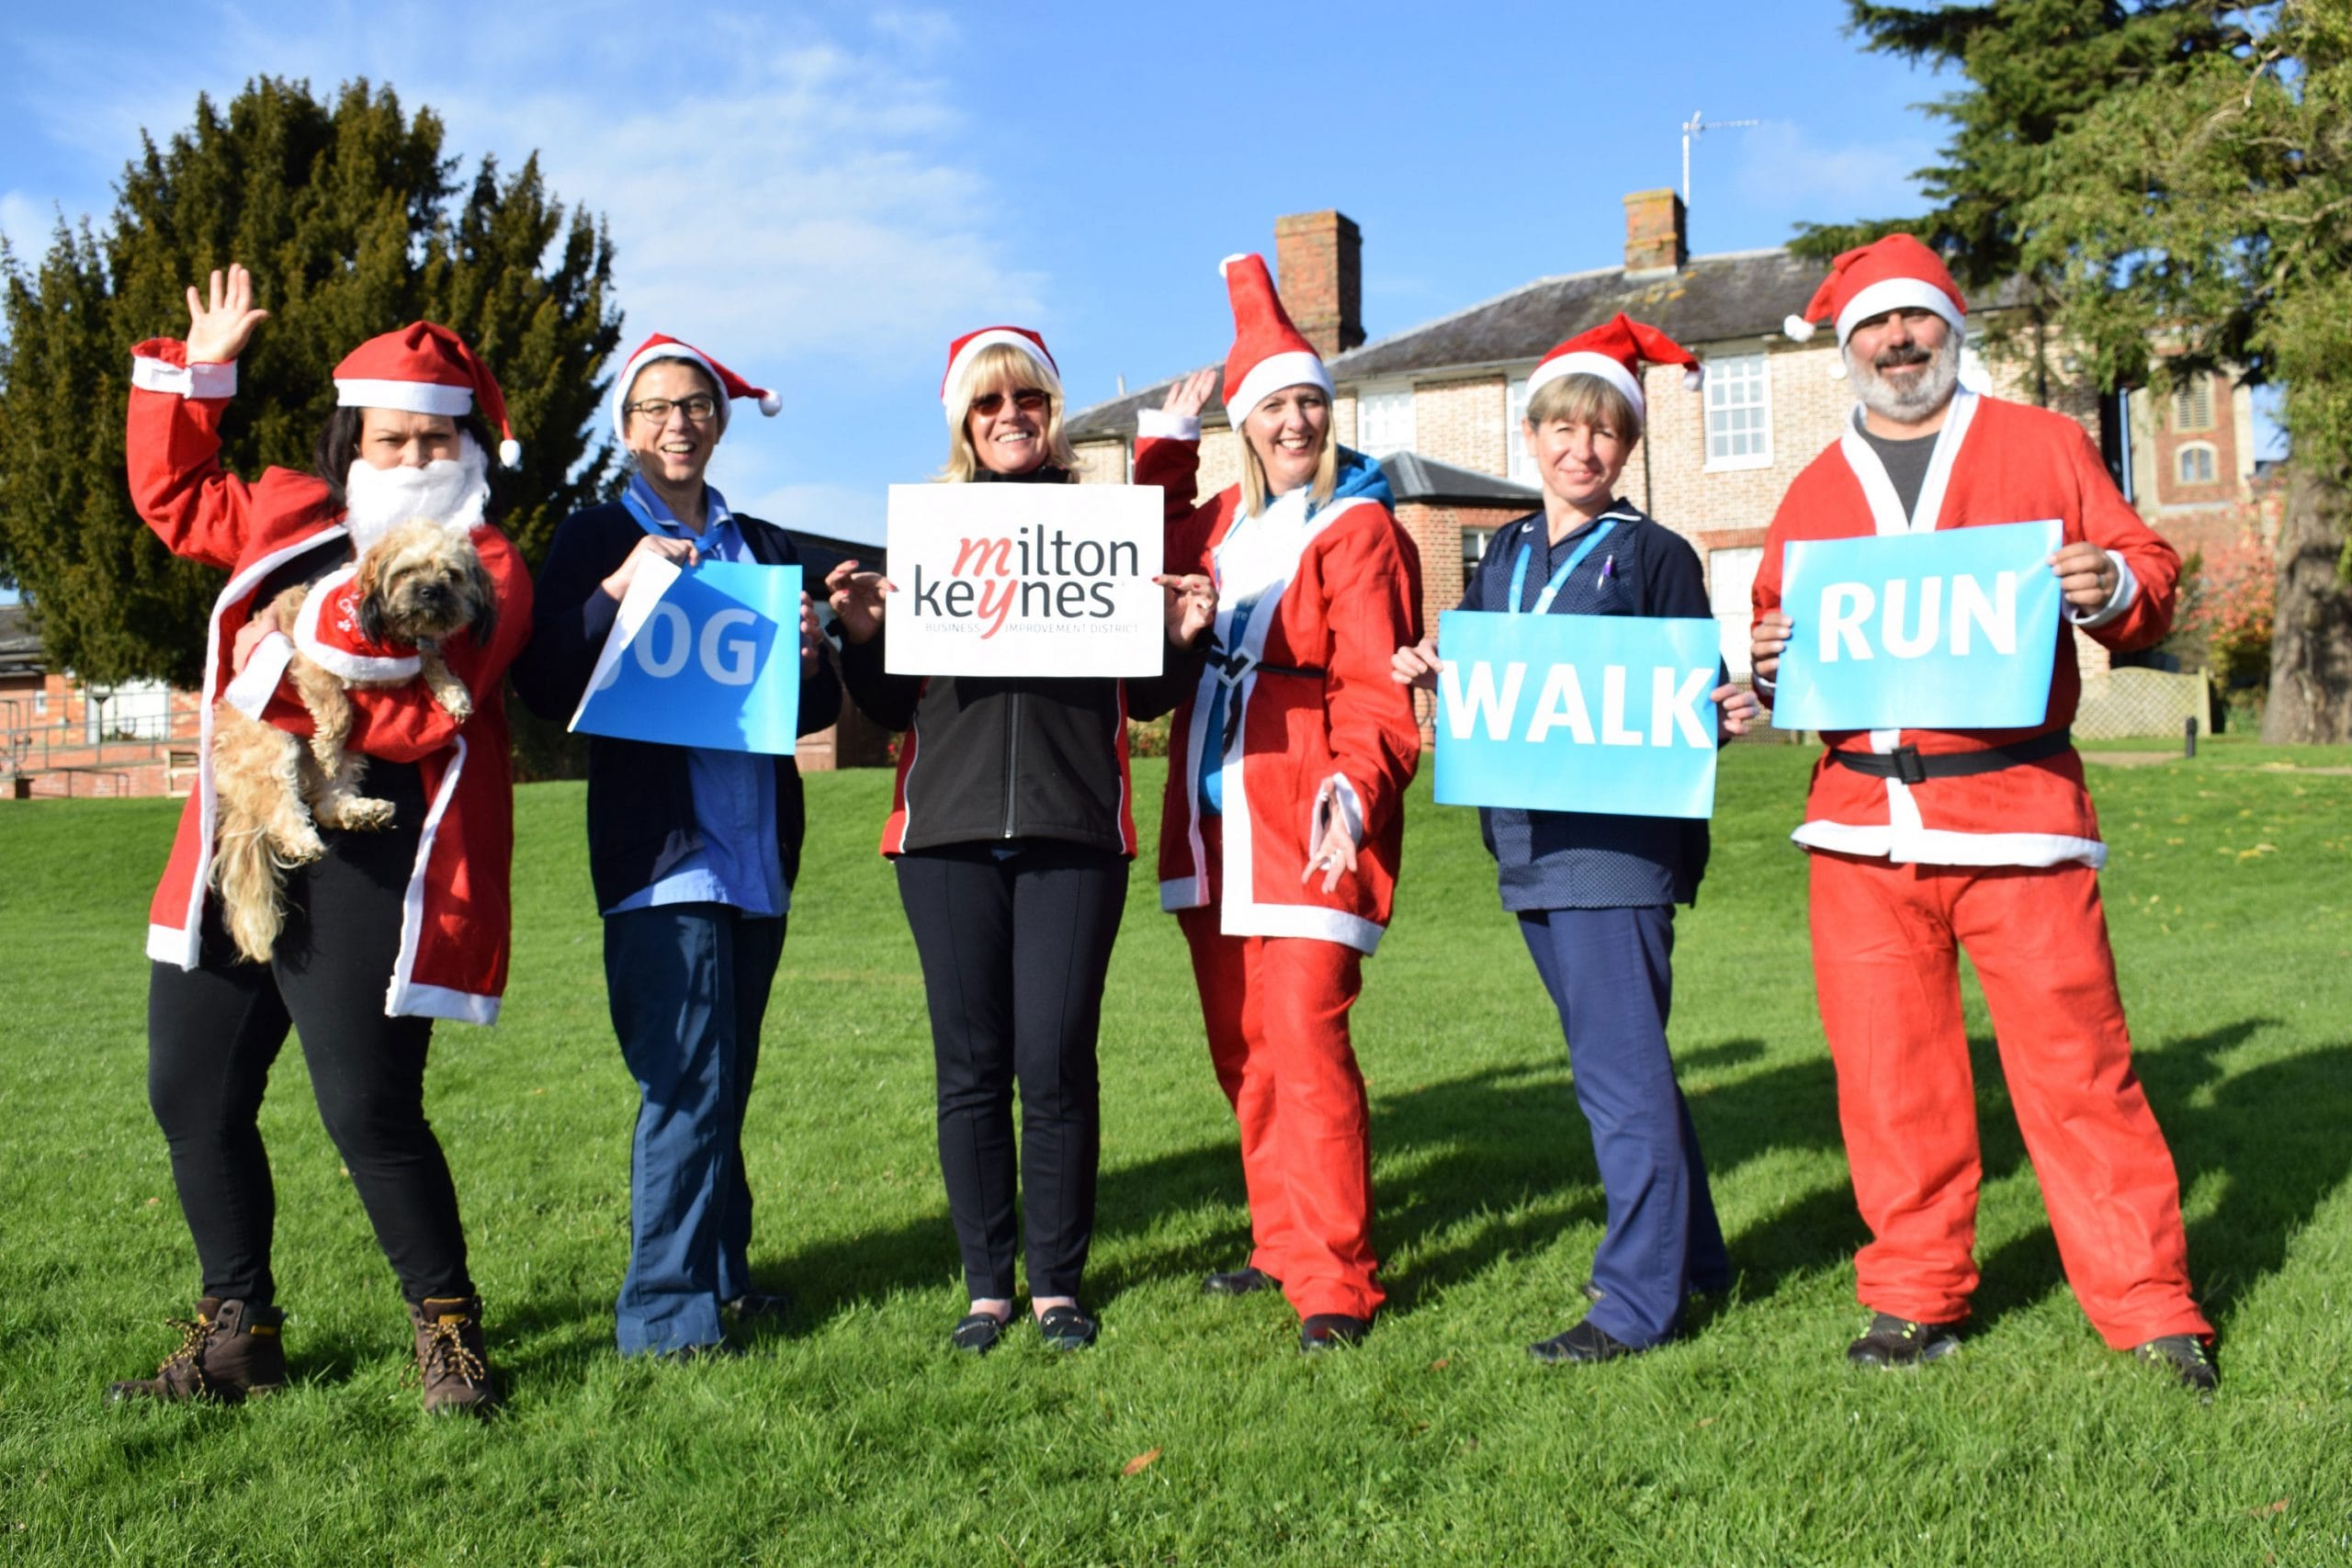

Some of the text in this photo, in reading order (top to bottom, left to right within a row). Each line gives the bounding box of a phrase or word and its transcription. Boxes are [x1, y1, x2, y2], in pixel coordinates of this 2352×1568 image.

[952, 524, 1138, 577] milton
[914, 564, 1115, 639] keynes
[925, 624, 1139, 634] BUSINESS IMPROVEMENT DISTRICT
[1818, 570, 2018, 662] RUN
[1439, 660, 1714, 749] WALK
